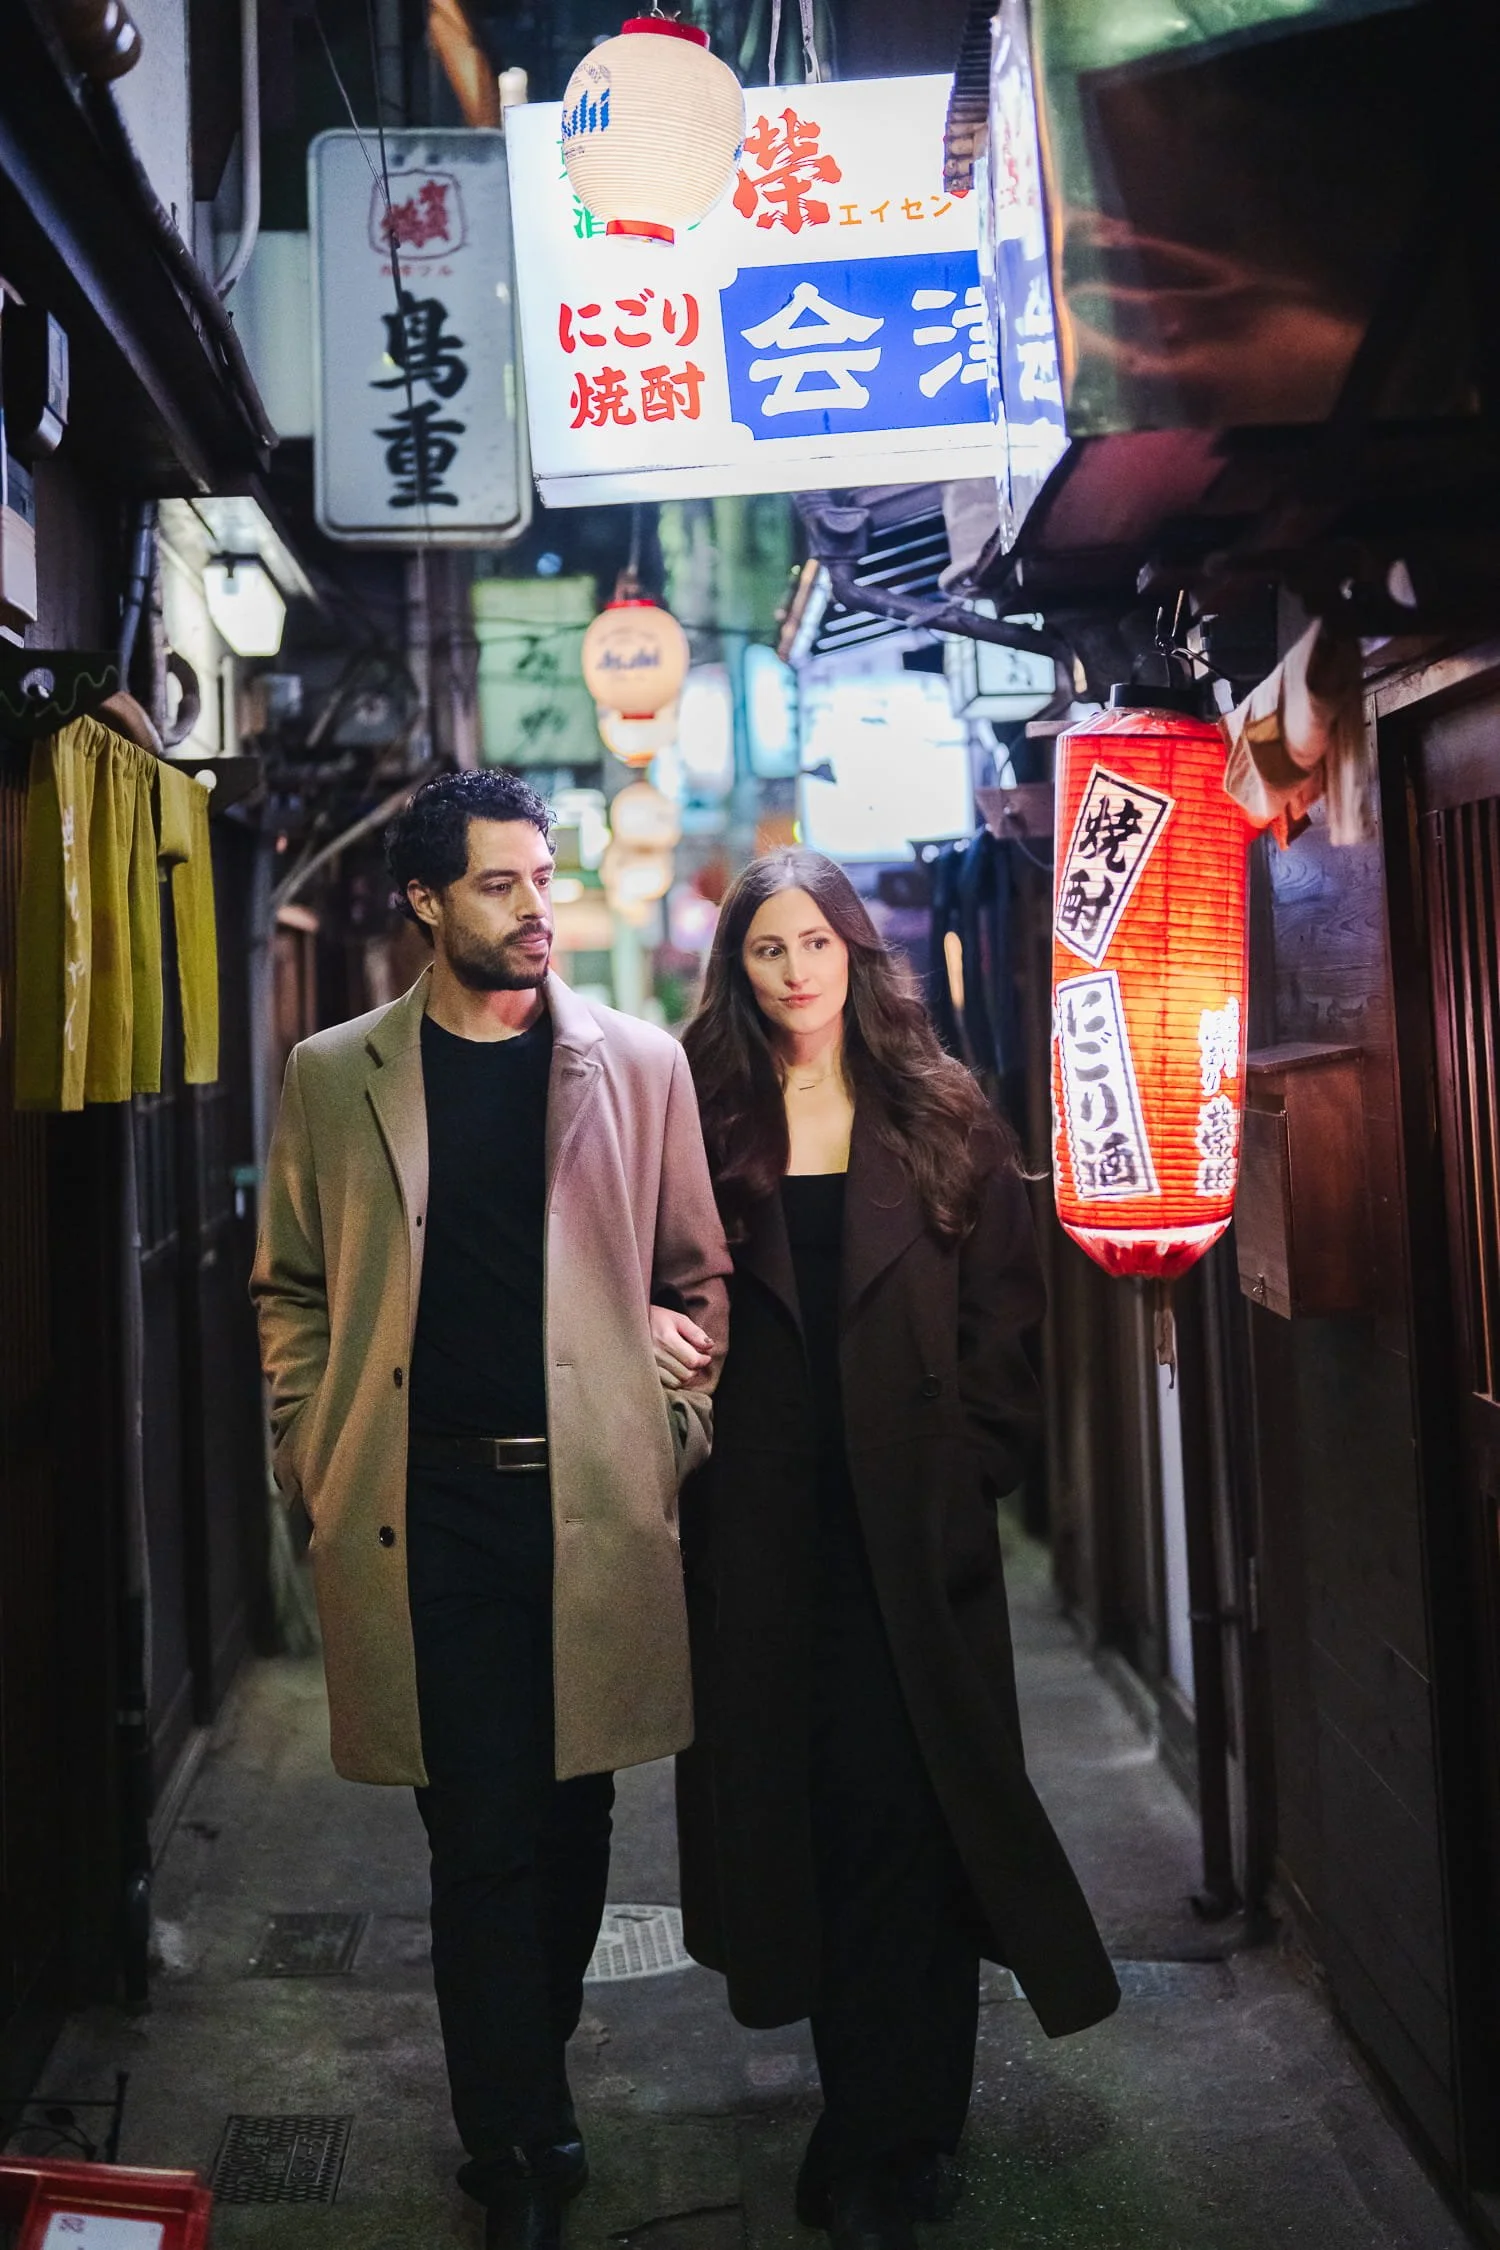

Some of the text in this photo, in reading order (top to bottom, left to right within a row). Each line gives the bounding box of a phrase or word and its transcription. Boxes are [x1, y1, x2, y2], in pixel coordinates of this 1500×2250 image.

[839, 196, 952, 226] エイセン
[558, 288, 700, 354] にごり
[369, 290, 468, 507] 鳥重
[569, 361, 705, 429] 焼酎
[1061, 795, 1144, 942] 焼酎
[1067, 990, 1139, 1190] にごり酒
